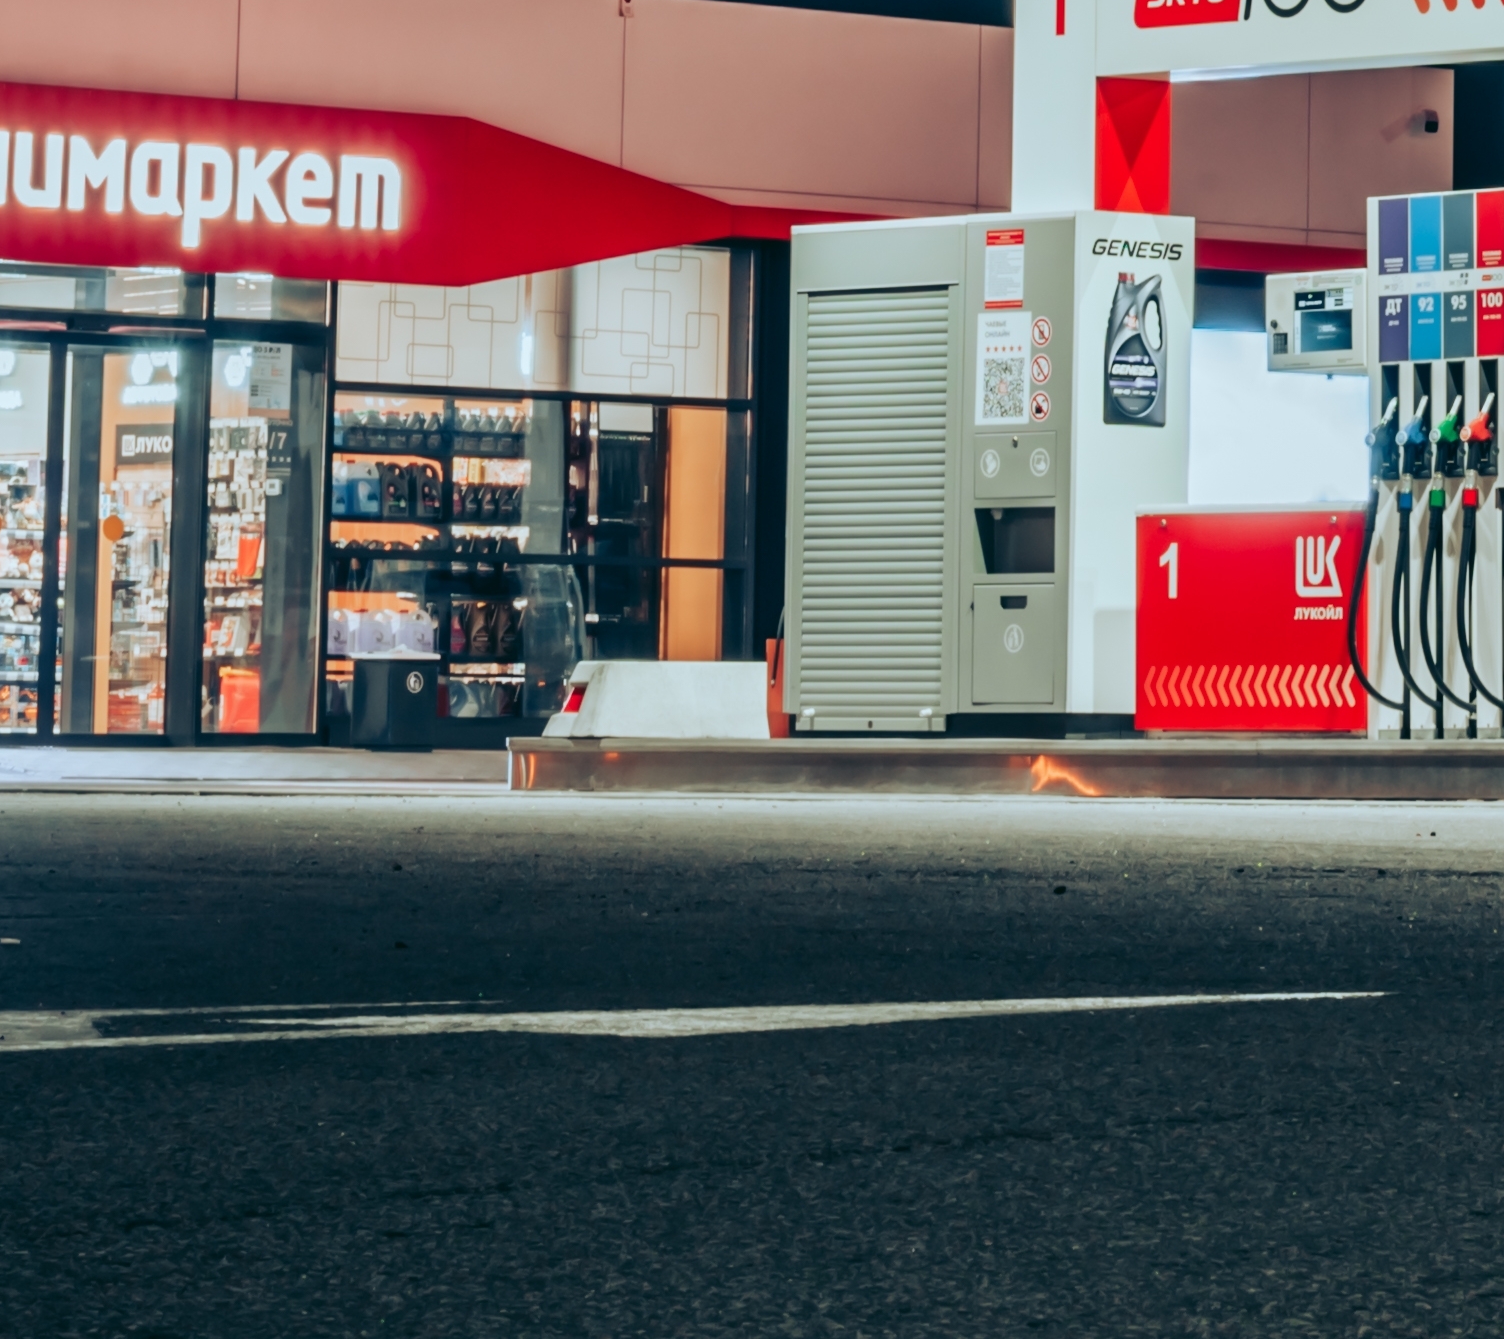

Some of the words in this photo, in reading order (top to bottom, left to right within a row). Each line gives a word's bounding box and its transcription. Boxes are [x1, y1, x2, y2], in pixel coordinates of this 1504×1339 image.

[1092, 238, 1183, 261] GENESIS
[1385, 298, 1402, 316] ДТ
[1418, 297, 1434, 312] 92
[1451, 294, 1467, 310] 95
[1481, 292, 1503, 308] 100
[1111, 363, 1156, 377] GENESIS
[1159, 542, 1178, 599] 1
[1294, 605, 1344, 621] ЛУКОЙЛ
